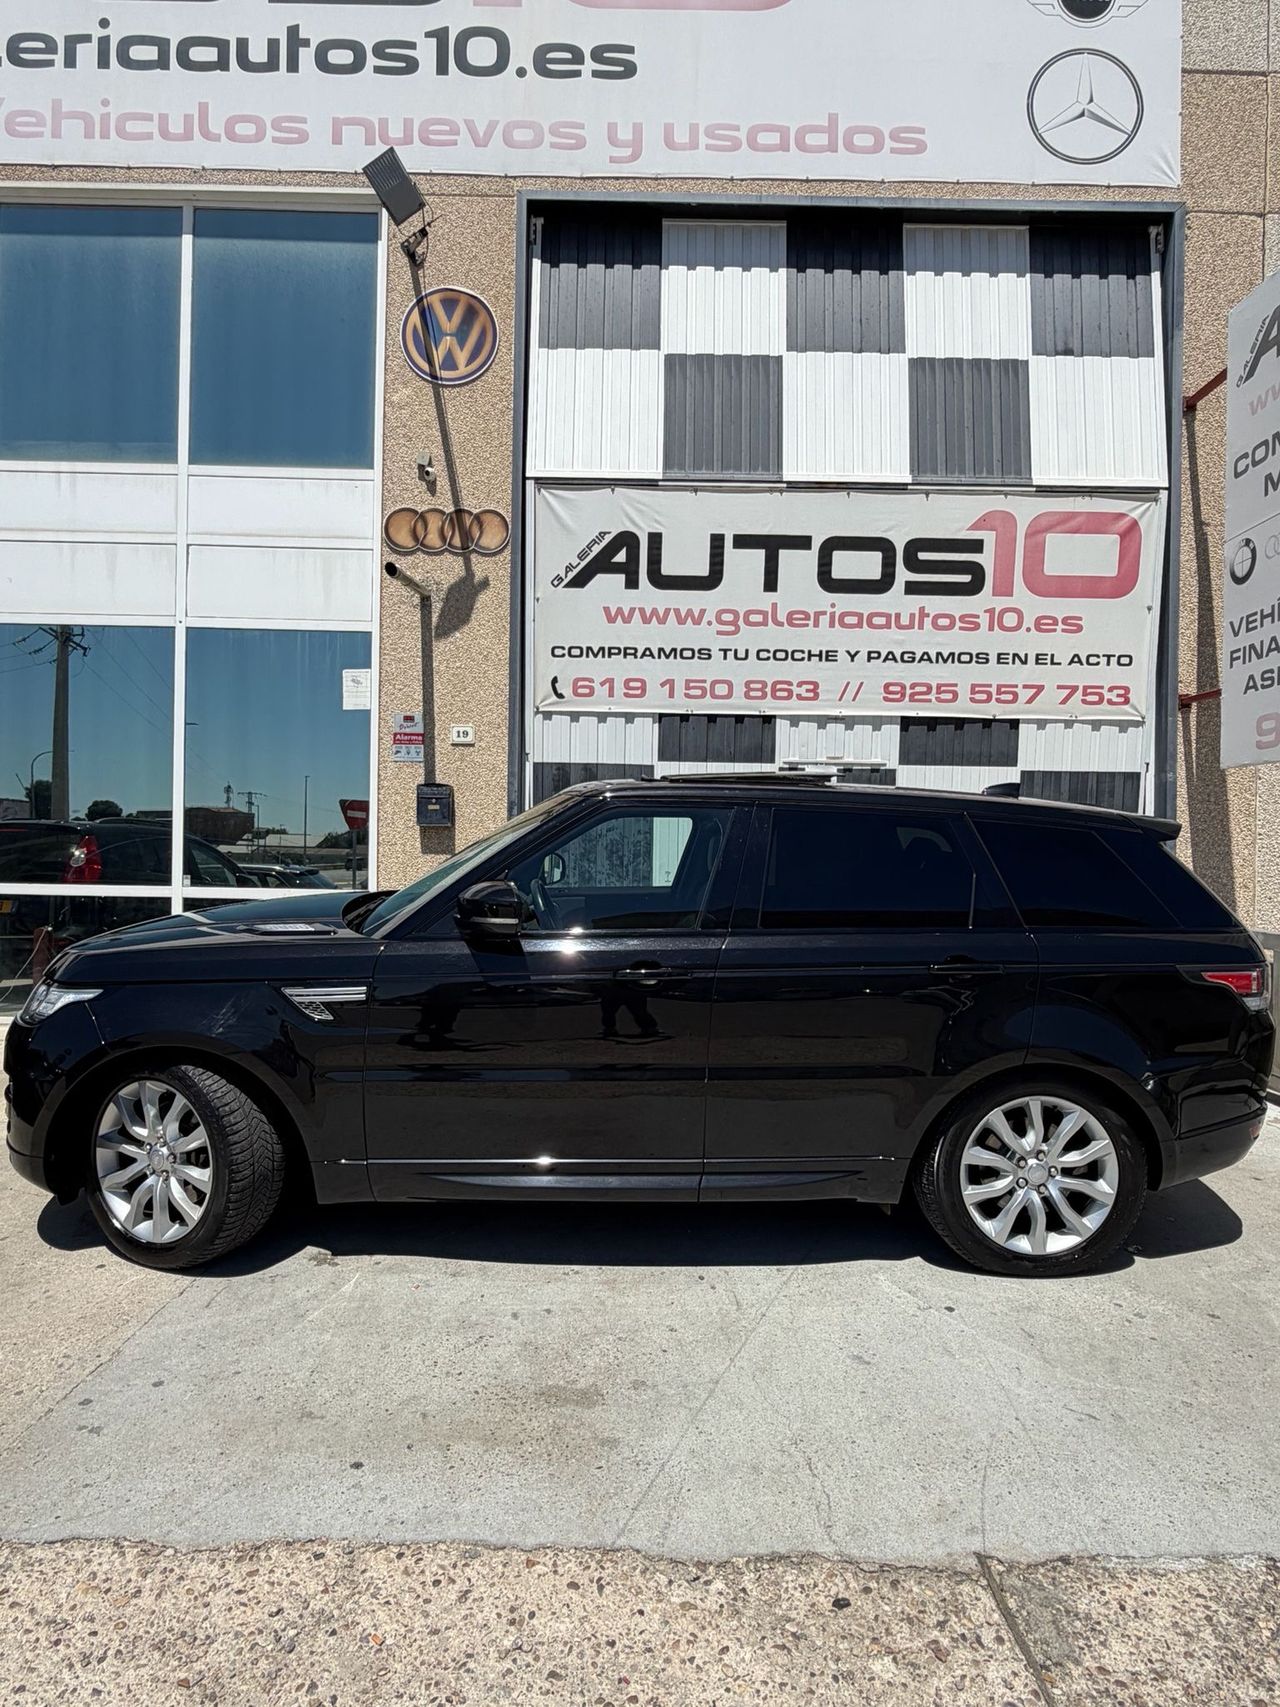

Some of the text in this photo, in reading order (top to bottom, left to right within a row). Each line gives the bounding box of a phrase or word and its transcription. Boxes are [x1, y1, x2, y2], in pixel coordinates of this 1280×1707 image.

[0, 17, 638, 80] eriaautos10.es
[0, 97, 928, 164] ehiculos nuevos y usados
[551, 531, 612, 588] GALERIA
[561, 510, 1142, 599] AUTOS10
[602, 602, 1084, 636] www.galeriaautos10.es
[550, 645, 1133, 667] COMPRAMOS TU COCHE Y PAGAMOS EN EL ACTO
[1229, 635, 1280, 669] FINA
[571, 676, 648, 699] 619
[659, 678, 734, 701] 150
[743, 679, 820, 702] 863
[882, 681, 959, 704] 925
[968, 683, 1045, 706] 557
[1055, 684, 1132, 707] 753
[1243, 666, 1280, 695] AS
[395, 733, 422, 741] Alarma
[455, 730, 469, 738] 19
